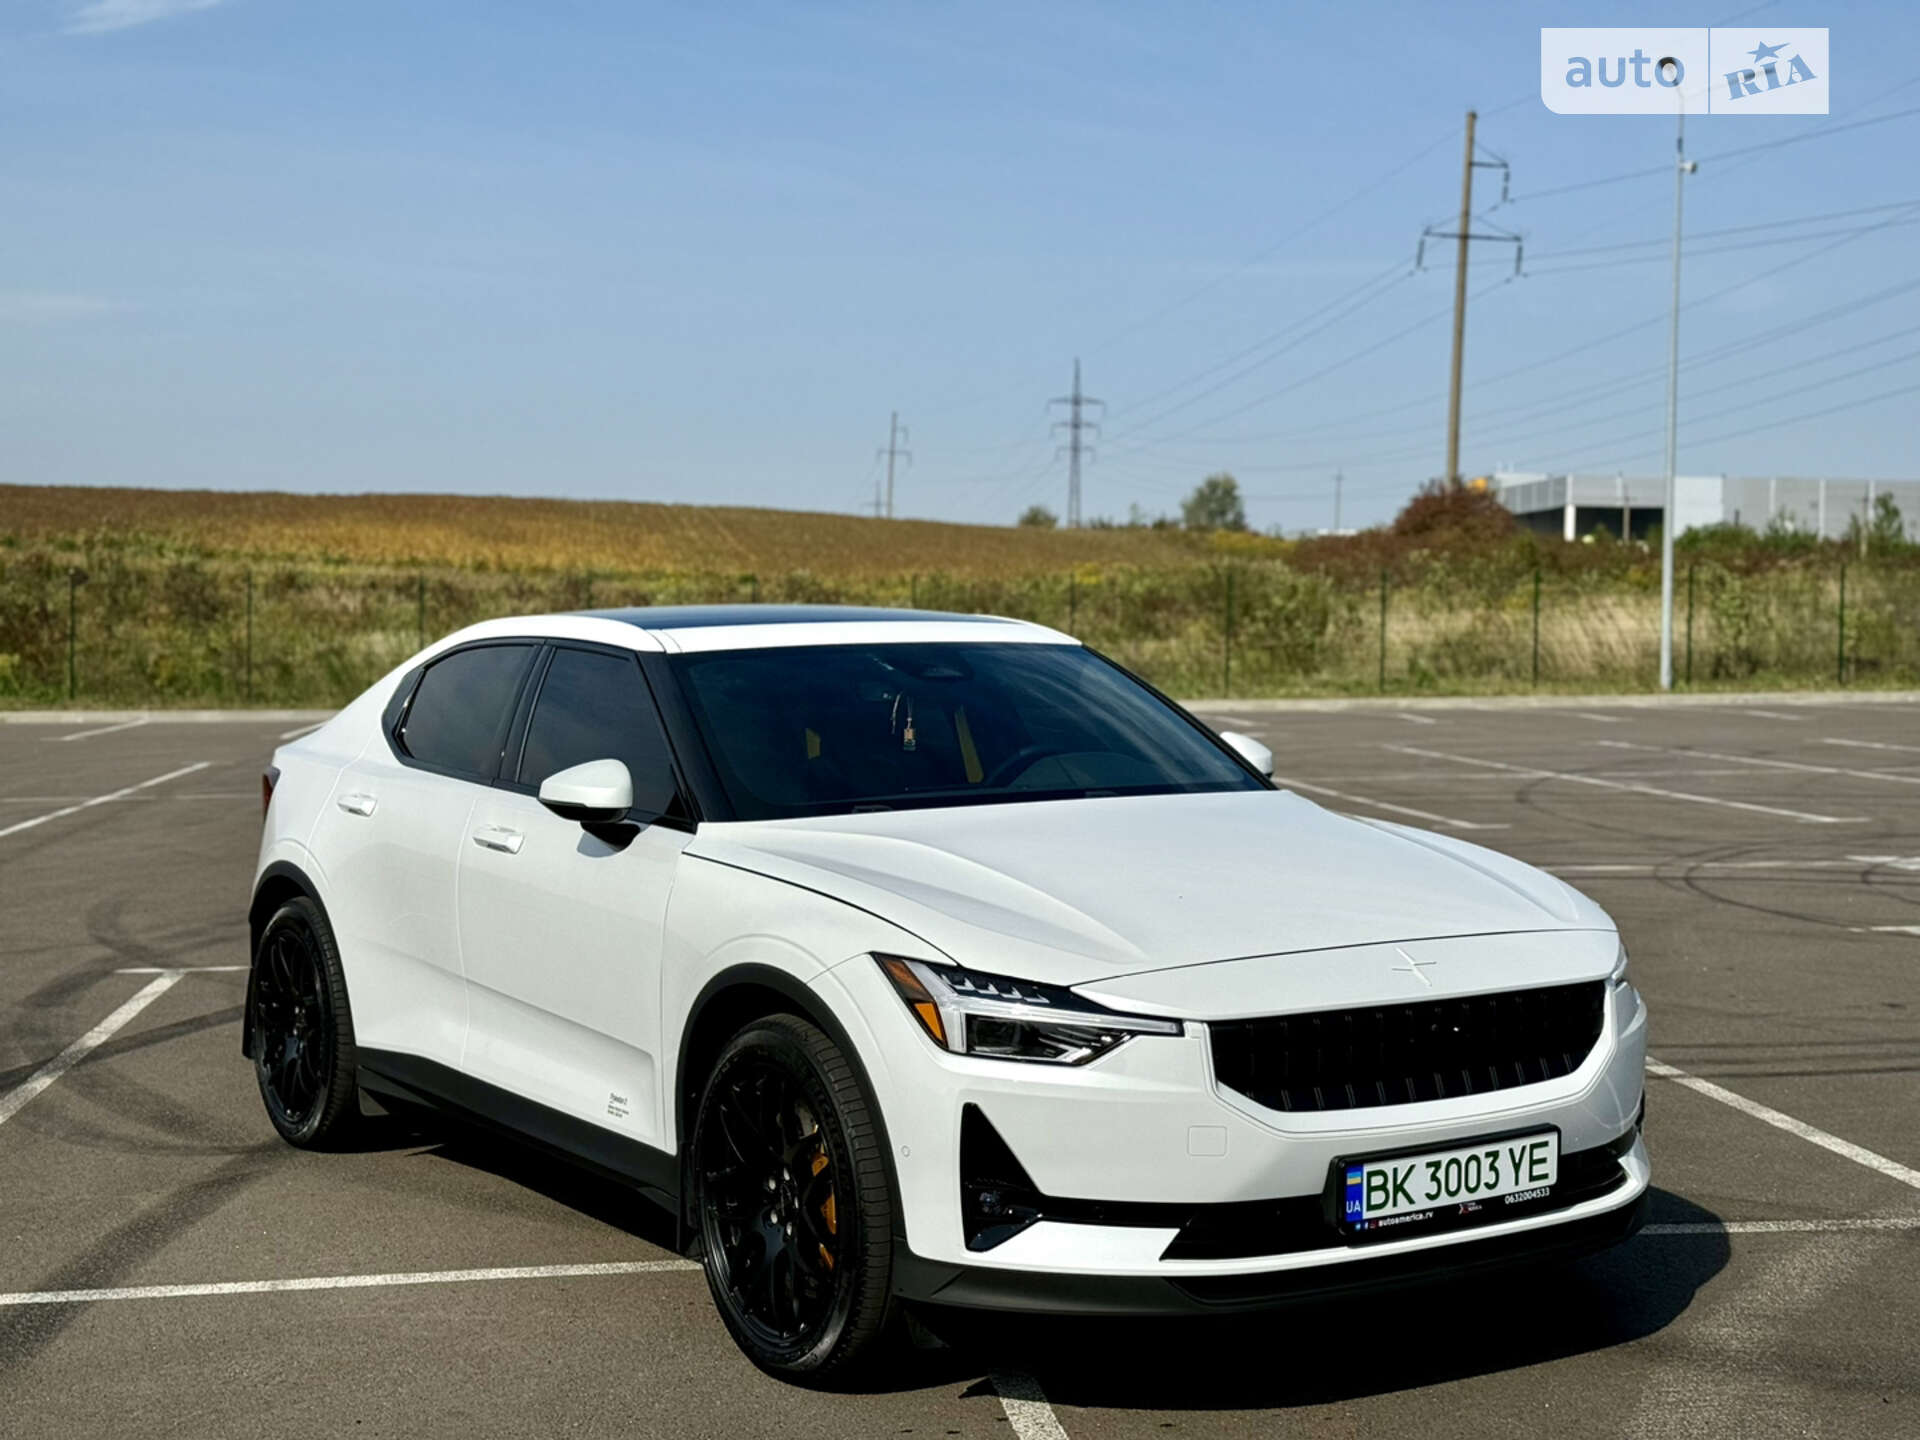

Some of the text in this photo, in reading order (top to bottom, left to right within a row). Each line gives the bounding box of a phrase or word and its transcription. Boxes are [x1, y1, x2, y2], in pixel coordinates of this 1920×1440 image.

[1366, 1140, 1550, 1212] BK 3003 YE
[1346, 1199, 1361, 1213] UA
